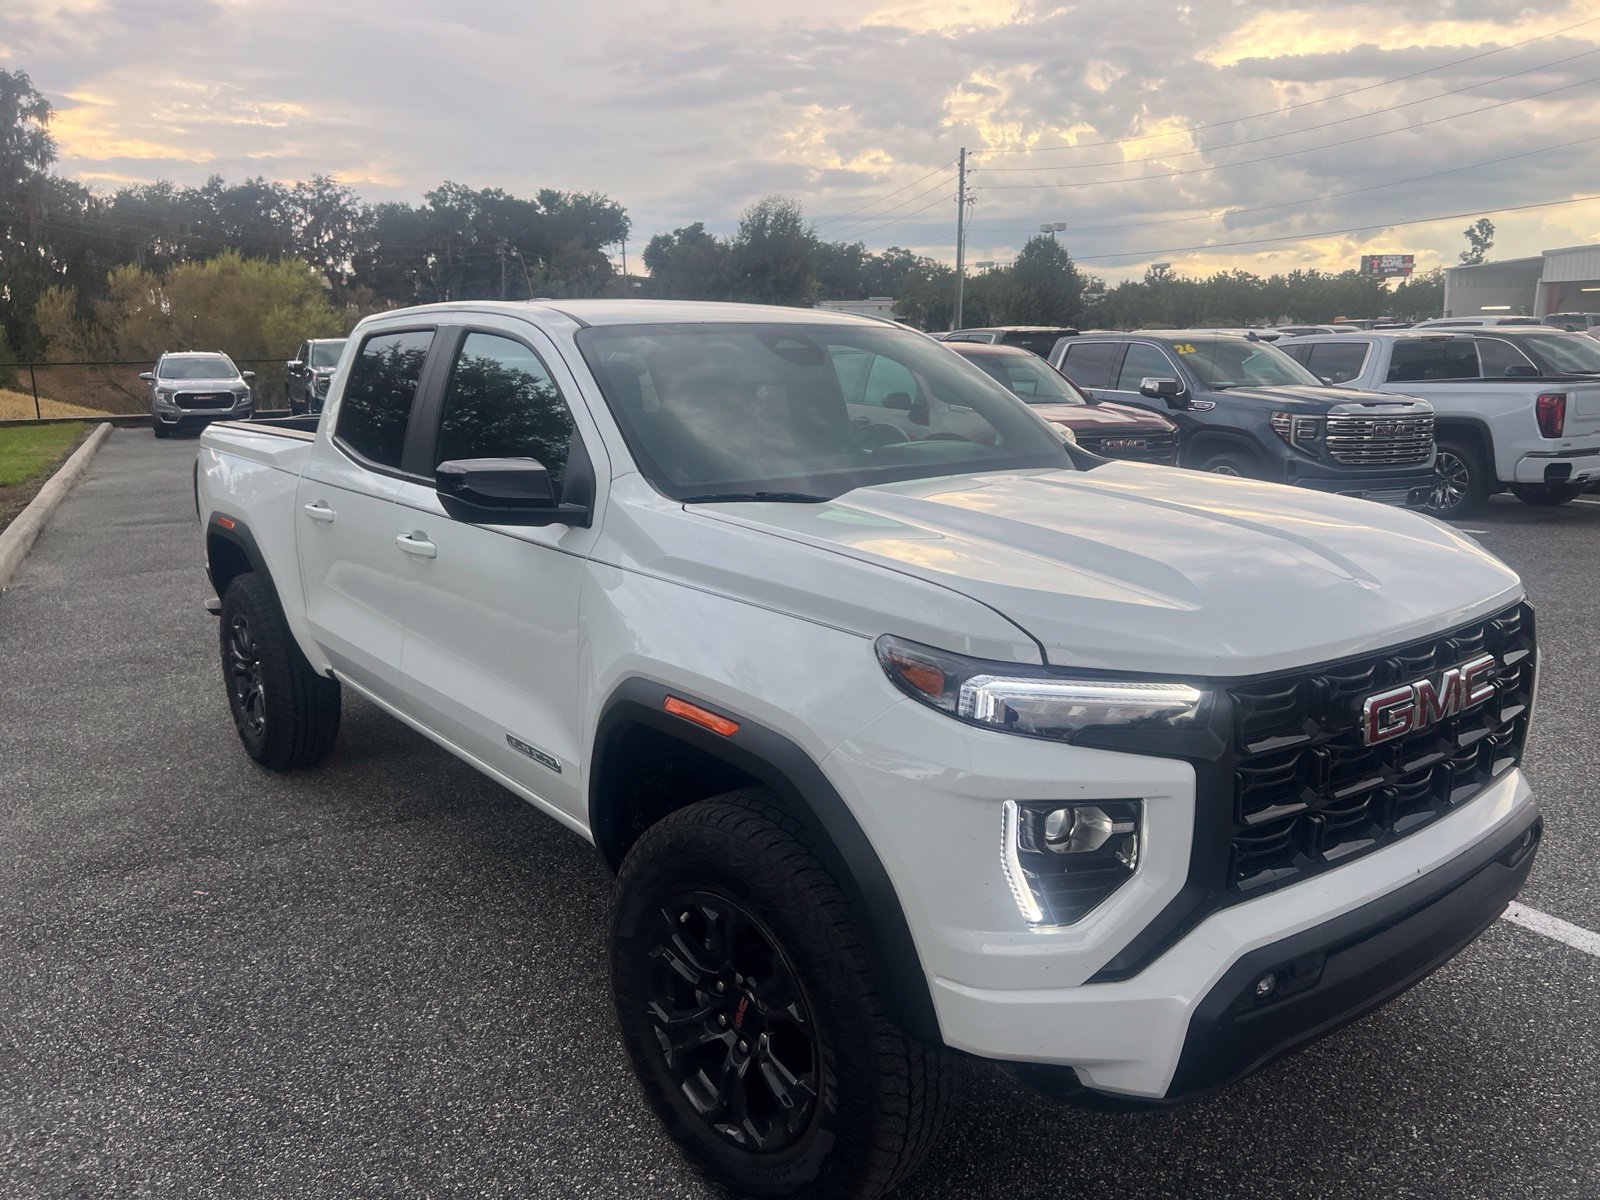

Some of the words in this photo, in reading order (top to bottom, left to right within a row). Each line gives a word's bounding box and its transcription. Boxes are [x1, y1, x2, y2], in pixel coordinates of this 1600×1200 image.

[1173, 343, 1197, 355] 26
[1375, 425, 1413, 436] GMC
[1363, 655, 1496, 746] GMC
